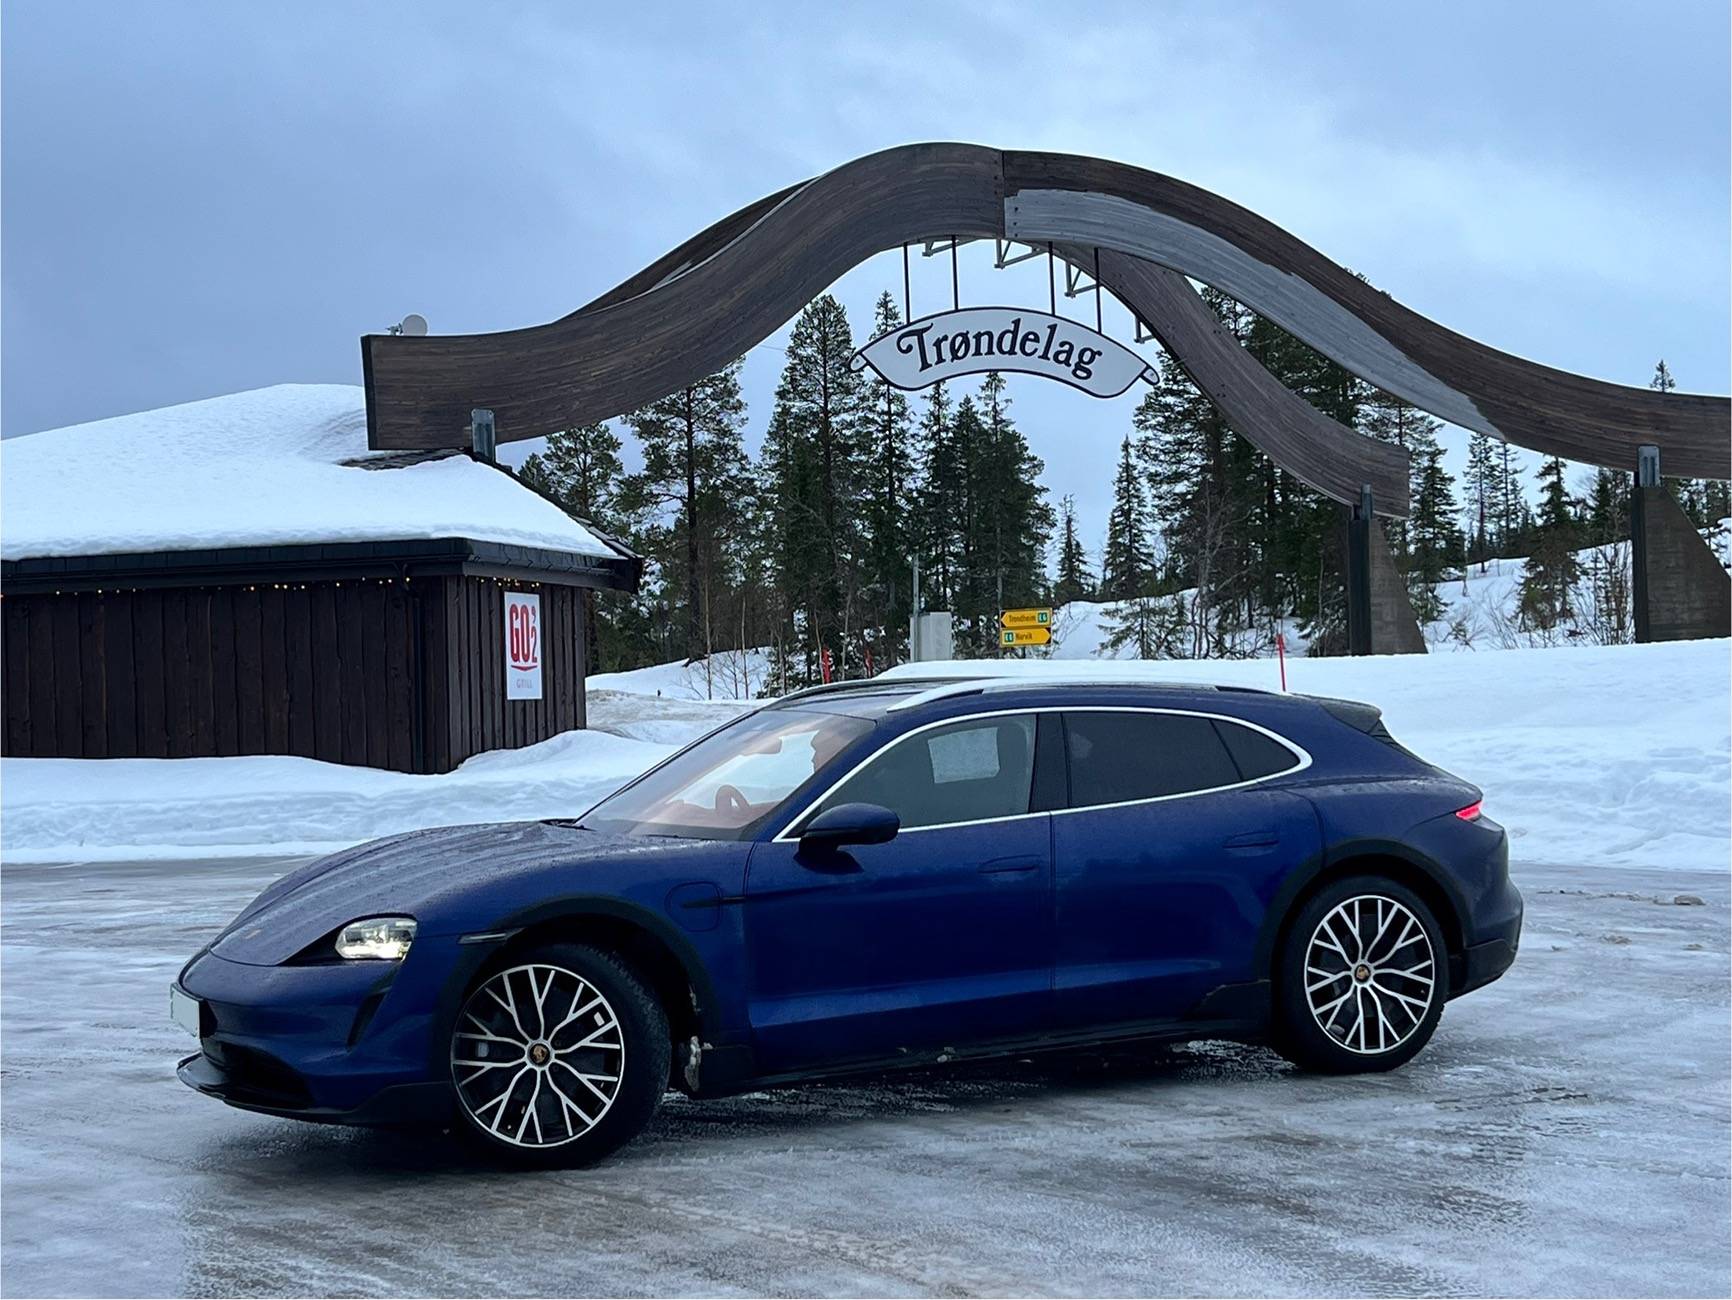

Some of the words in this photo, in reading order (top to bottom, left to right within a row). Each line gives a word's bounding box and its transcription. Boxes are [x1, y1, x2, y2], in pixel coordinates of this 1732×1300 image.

[896, 317, 1103, 380] Trøndelag
[1008, 614, 1036, 623] Trondheim
[1016, 632, 1033, 640] Narvik
